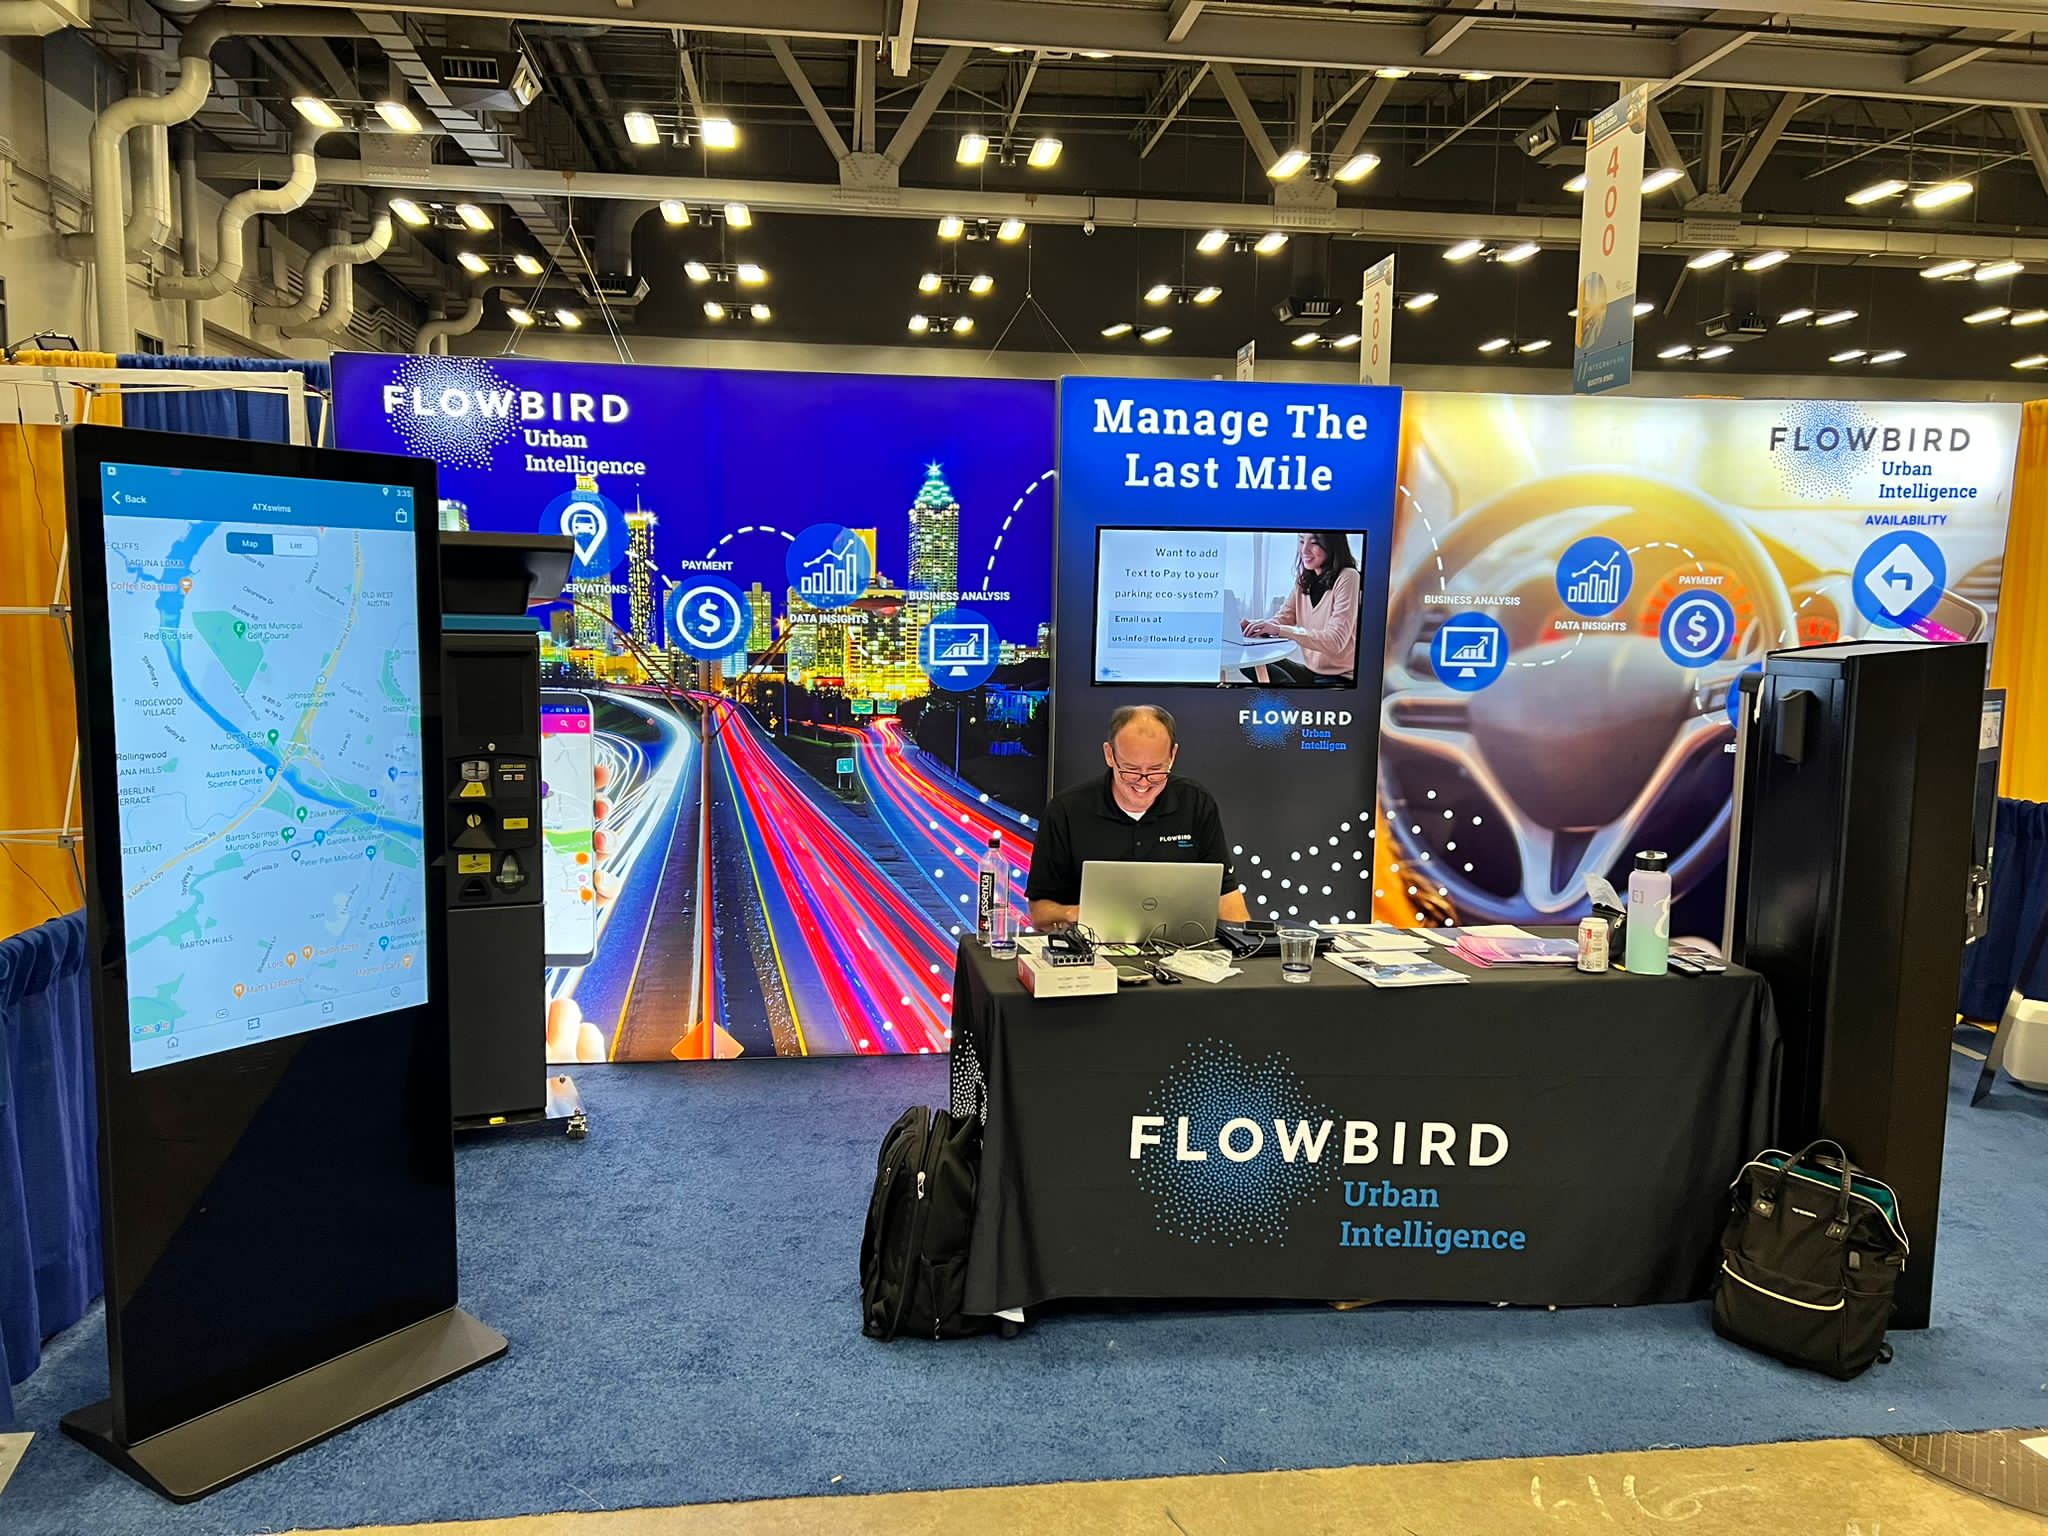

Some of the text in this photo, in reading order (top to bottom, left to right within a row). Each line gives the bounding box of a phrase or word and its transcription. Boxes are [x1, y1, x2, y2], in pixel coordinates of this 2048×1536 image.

[1602, 146, 1619, 256] 400
[1372, 292, 1381, 366] 300
[383, 385, 629, 422] FLOWBIRD
[1093, 398, 1368, 446] Manage The
[523, 429, 588, 449] Urban
[1769, 426, 1971, 452] FLOWBIRD
[525, 454, 646, 478] Intelligence
[1124, 453, 1333, 491] Last Mile
[1882, 461, 1932, 476] Urban
[125, 494, 147, 504] Back
[1878, 484, 1978, 502] Intelligence
[1865, 514, 1948, 526] AVAILABILITY
[241, 539, 259, 549] Map
[1155, 548, 1218, 558] Want to add
[681, 560, 733, 571] PAYMENT
[1125, 568, 1219, 580] Text to Pay to your
[1679, 575, 1724, 585] PAYMENT
[909, 591, 1010, 601] BUSINESS ANALYSIS
[1115, 589, 1219, 600] parking eco-system?
[1424, 594, 1521, 606] BUSINESS ANALYSIS
[789, 614, 869, 624] DATA INSIGHTS
[1115, 615, 1139, 623] Email
[1555, 620, 1626, 631] DATA INSIGHTS
[143, 632, 160, 640] Red
[143, 708, 177, 716] VILLAGE
[1239, 710, 1352, 725] FLOWBIRD
[1301, 729, 1331, 738] Urban
[206, 770, 230, 778] Austin
[231, 769, 256, 777] Nature
[208, 780, 237, 788] Science
[1159, 834, 1192, 842] FLOWBIRD
[980, 874, 990, 916] essentia
[179, 938, 211, 950] BARTON
[133, 1021, 169, 1034] Google
[1129, 1115, 1510, 1167] FLOWBIRD
[1343, 1180, 1440, 1208] Urban
[1339, 1220, 1527, 1254] Intelligence
